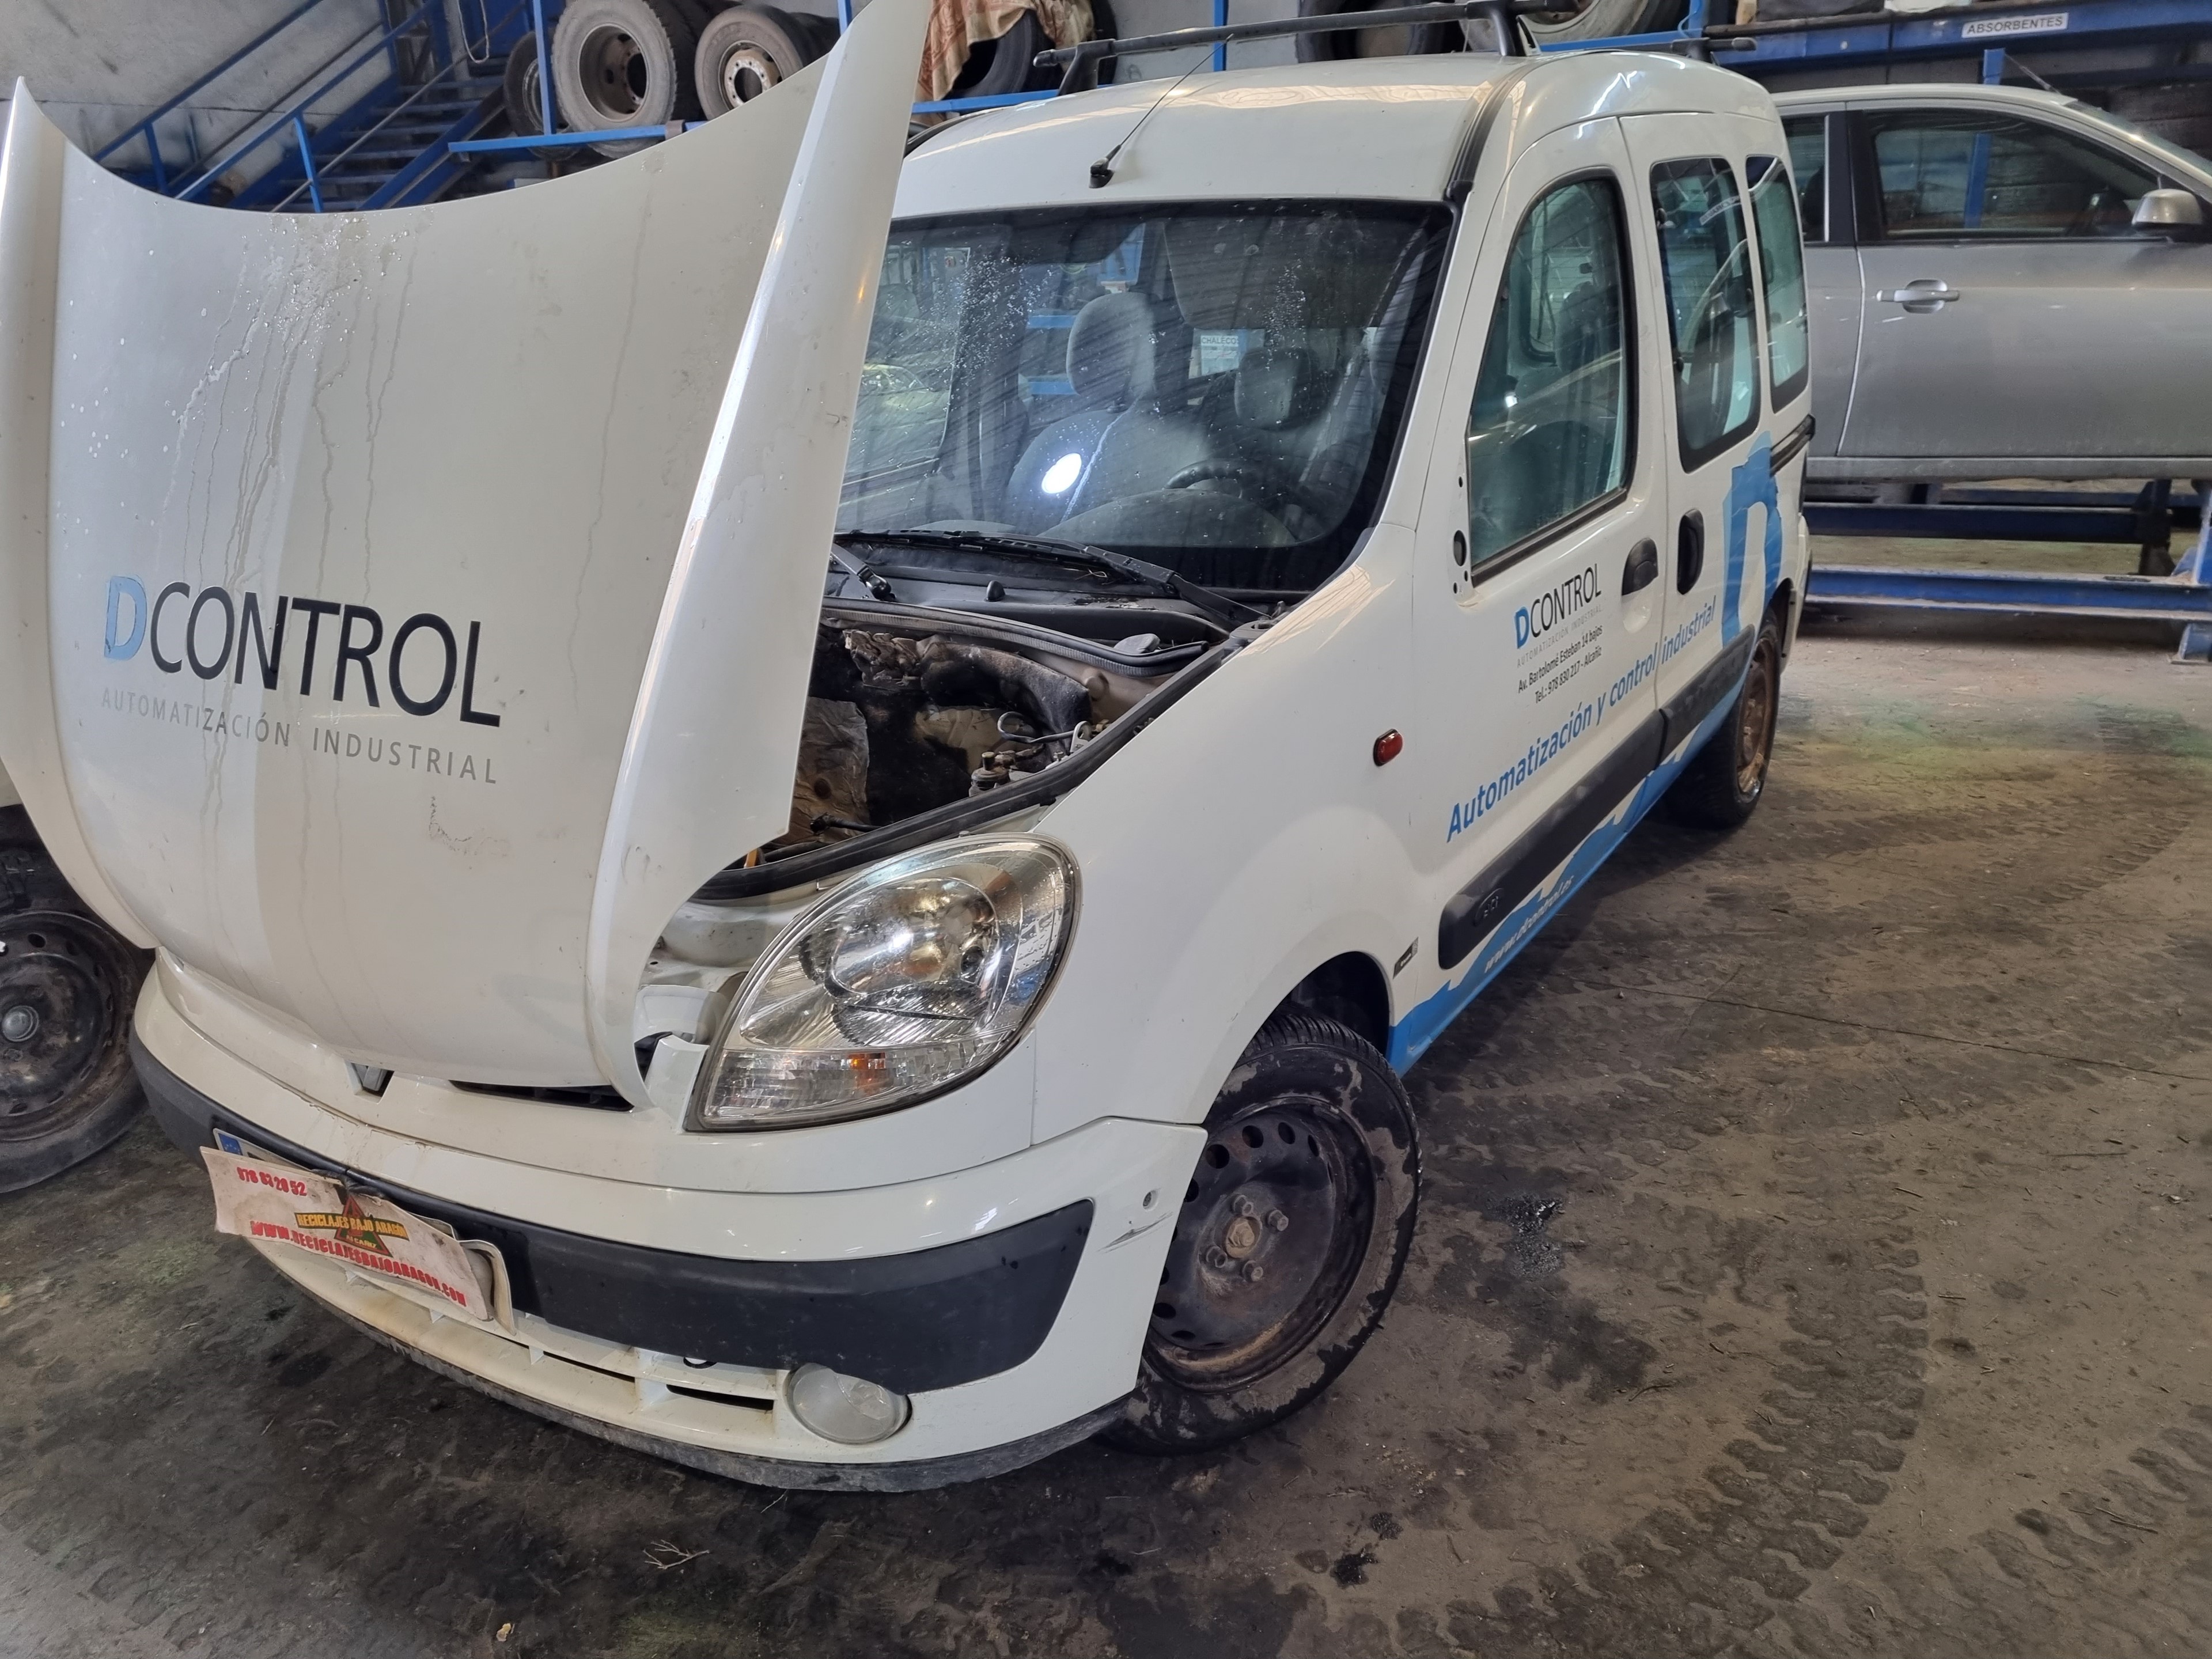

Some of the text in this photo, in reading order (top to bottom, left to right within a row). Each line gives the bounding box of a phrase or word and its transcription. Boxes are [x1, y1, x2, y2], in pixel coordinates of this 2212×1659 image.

[1967, 17, 2063, 35] ABSORBENTES
[1514, 563, 1601, 649] DCONTROL
[103, 575, 501, 728] DCONTROL
[1529, 653, 1558, 685] Bartolomé
[1560, 641, 1581, 663] Esteban
[1589, 625, 1603, 642] bajos
[1548, 676, 1559, 694] 978
[1584, 645, 1602, 667] Alcañiz
[101, 687, 497, 785] AUTOMATIZACIÓN INDUSTRIAL
[1447, 595, 1717, 843] Automatización y control industrial
[289, 1180, 308, 1196] 52
[297, 1214, 349, 1229] RECICLAJES
[350, 1218, 374, 1232] BAJO
